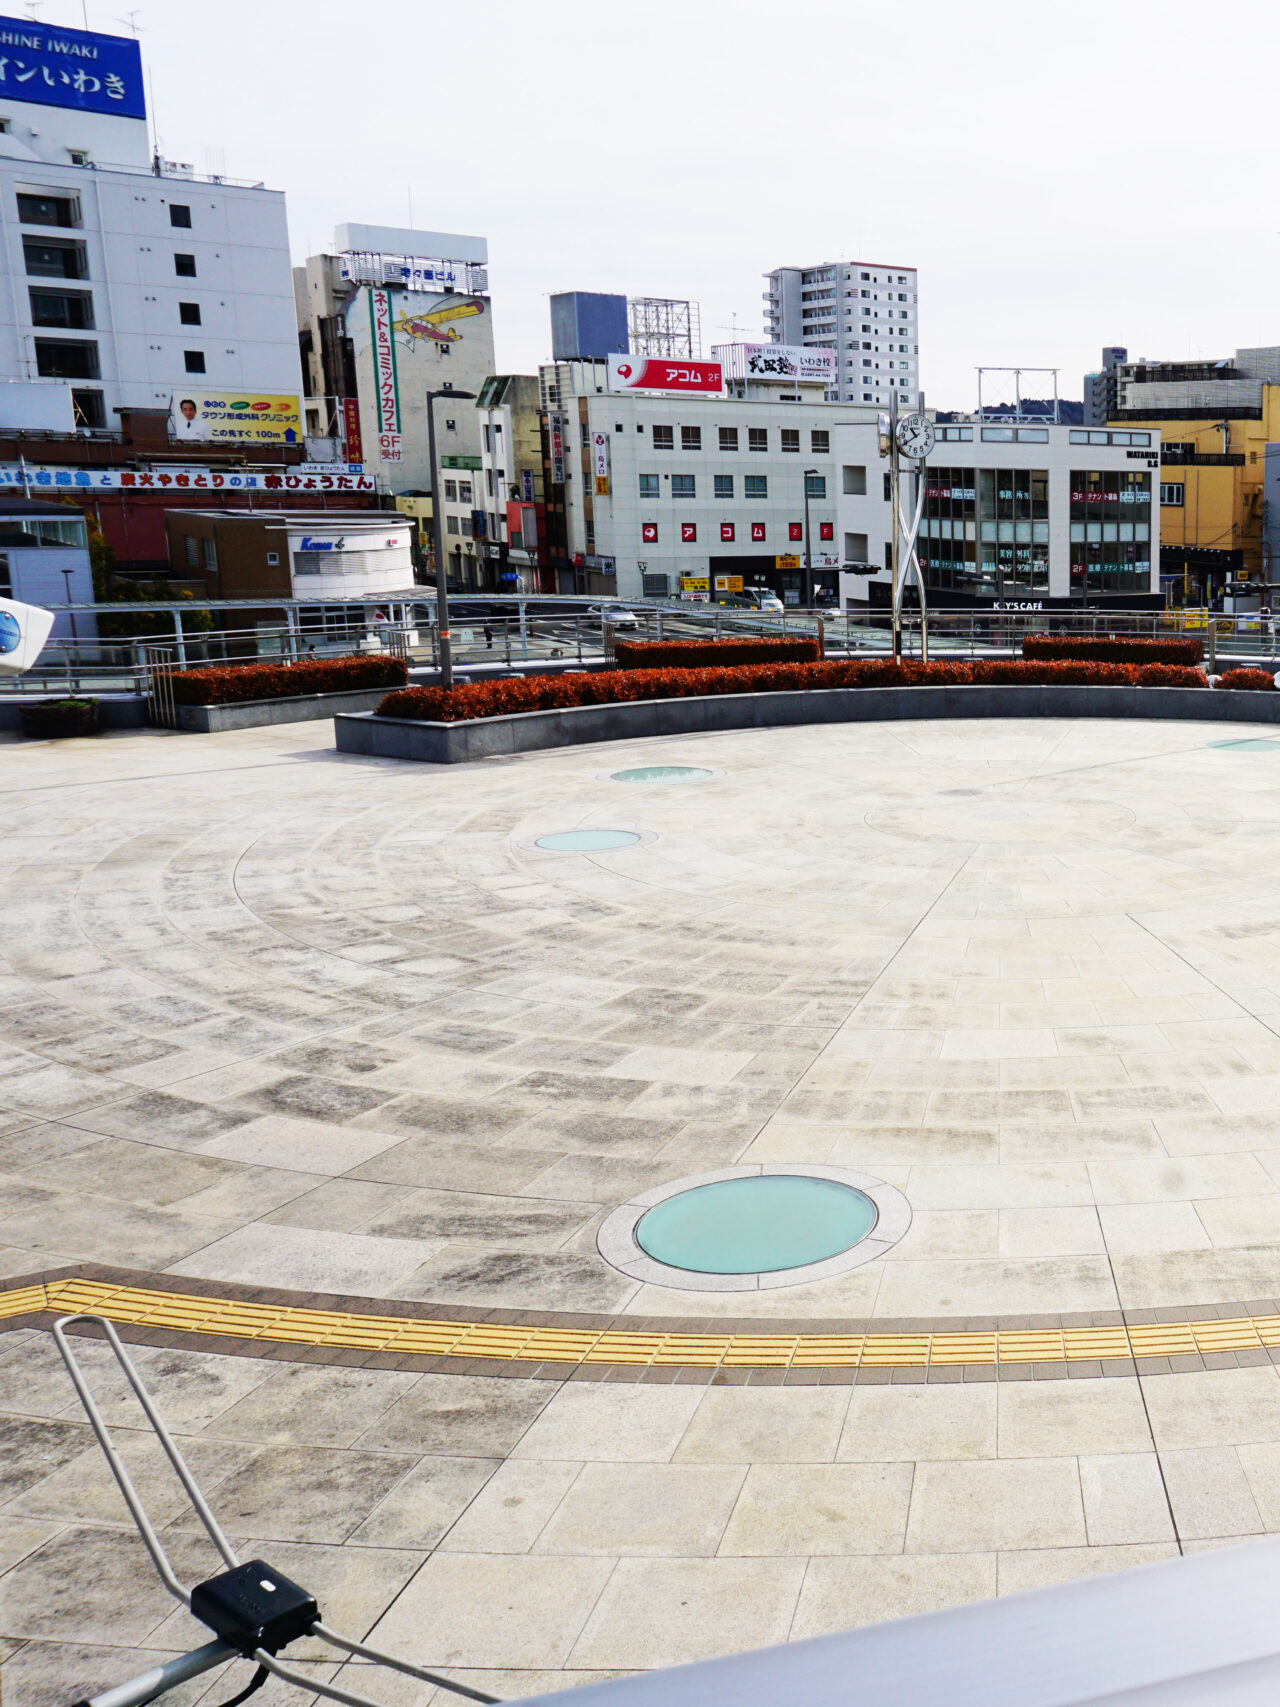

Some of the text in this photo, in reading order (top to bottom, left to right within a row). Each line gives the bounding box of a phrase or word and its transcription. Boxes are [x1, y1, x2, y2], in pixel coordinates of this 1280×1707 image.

[0, 32, 97, 59] HINE IWAKI
[666, 368, 720, 383] アコム 2F
[211, 429, 281, 438] この先すぐ 100m
[380, 435, 400, 447] 6F
[381, 450, 400, 460] 受付
[120, 473, 224, 488] 炭火やきとり
[1072, 492, 1083, 501] 3F
[1072, 564, 1083, 573] 2F
[993, 601, 1019, 610] KY'S
